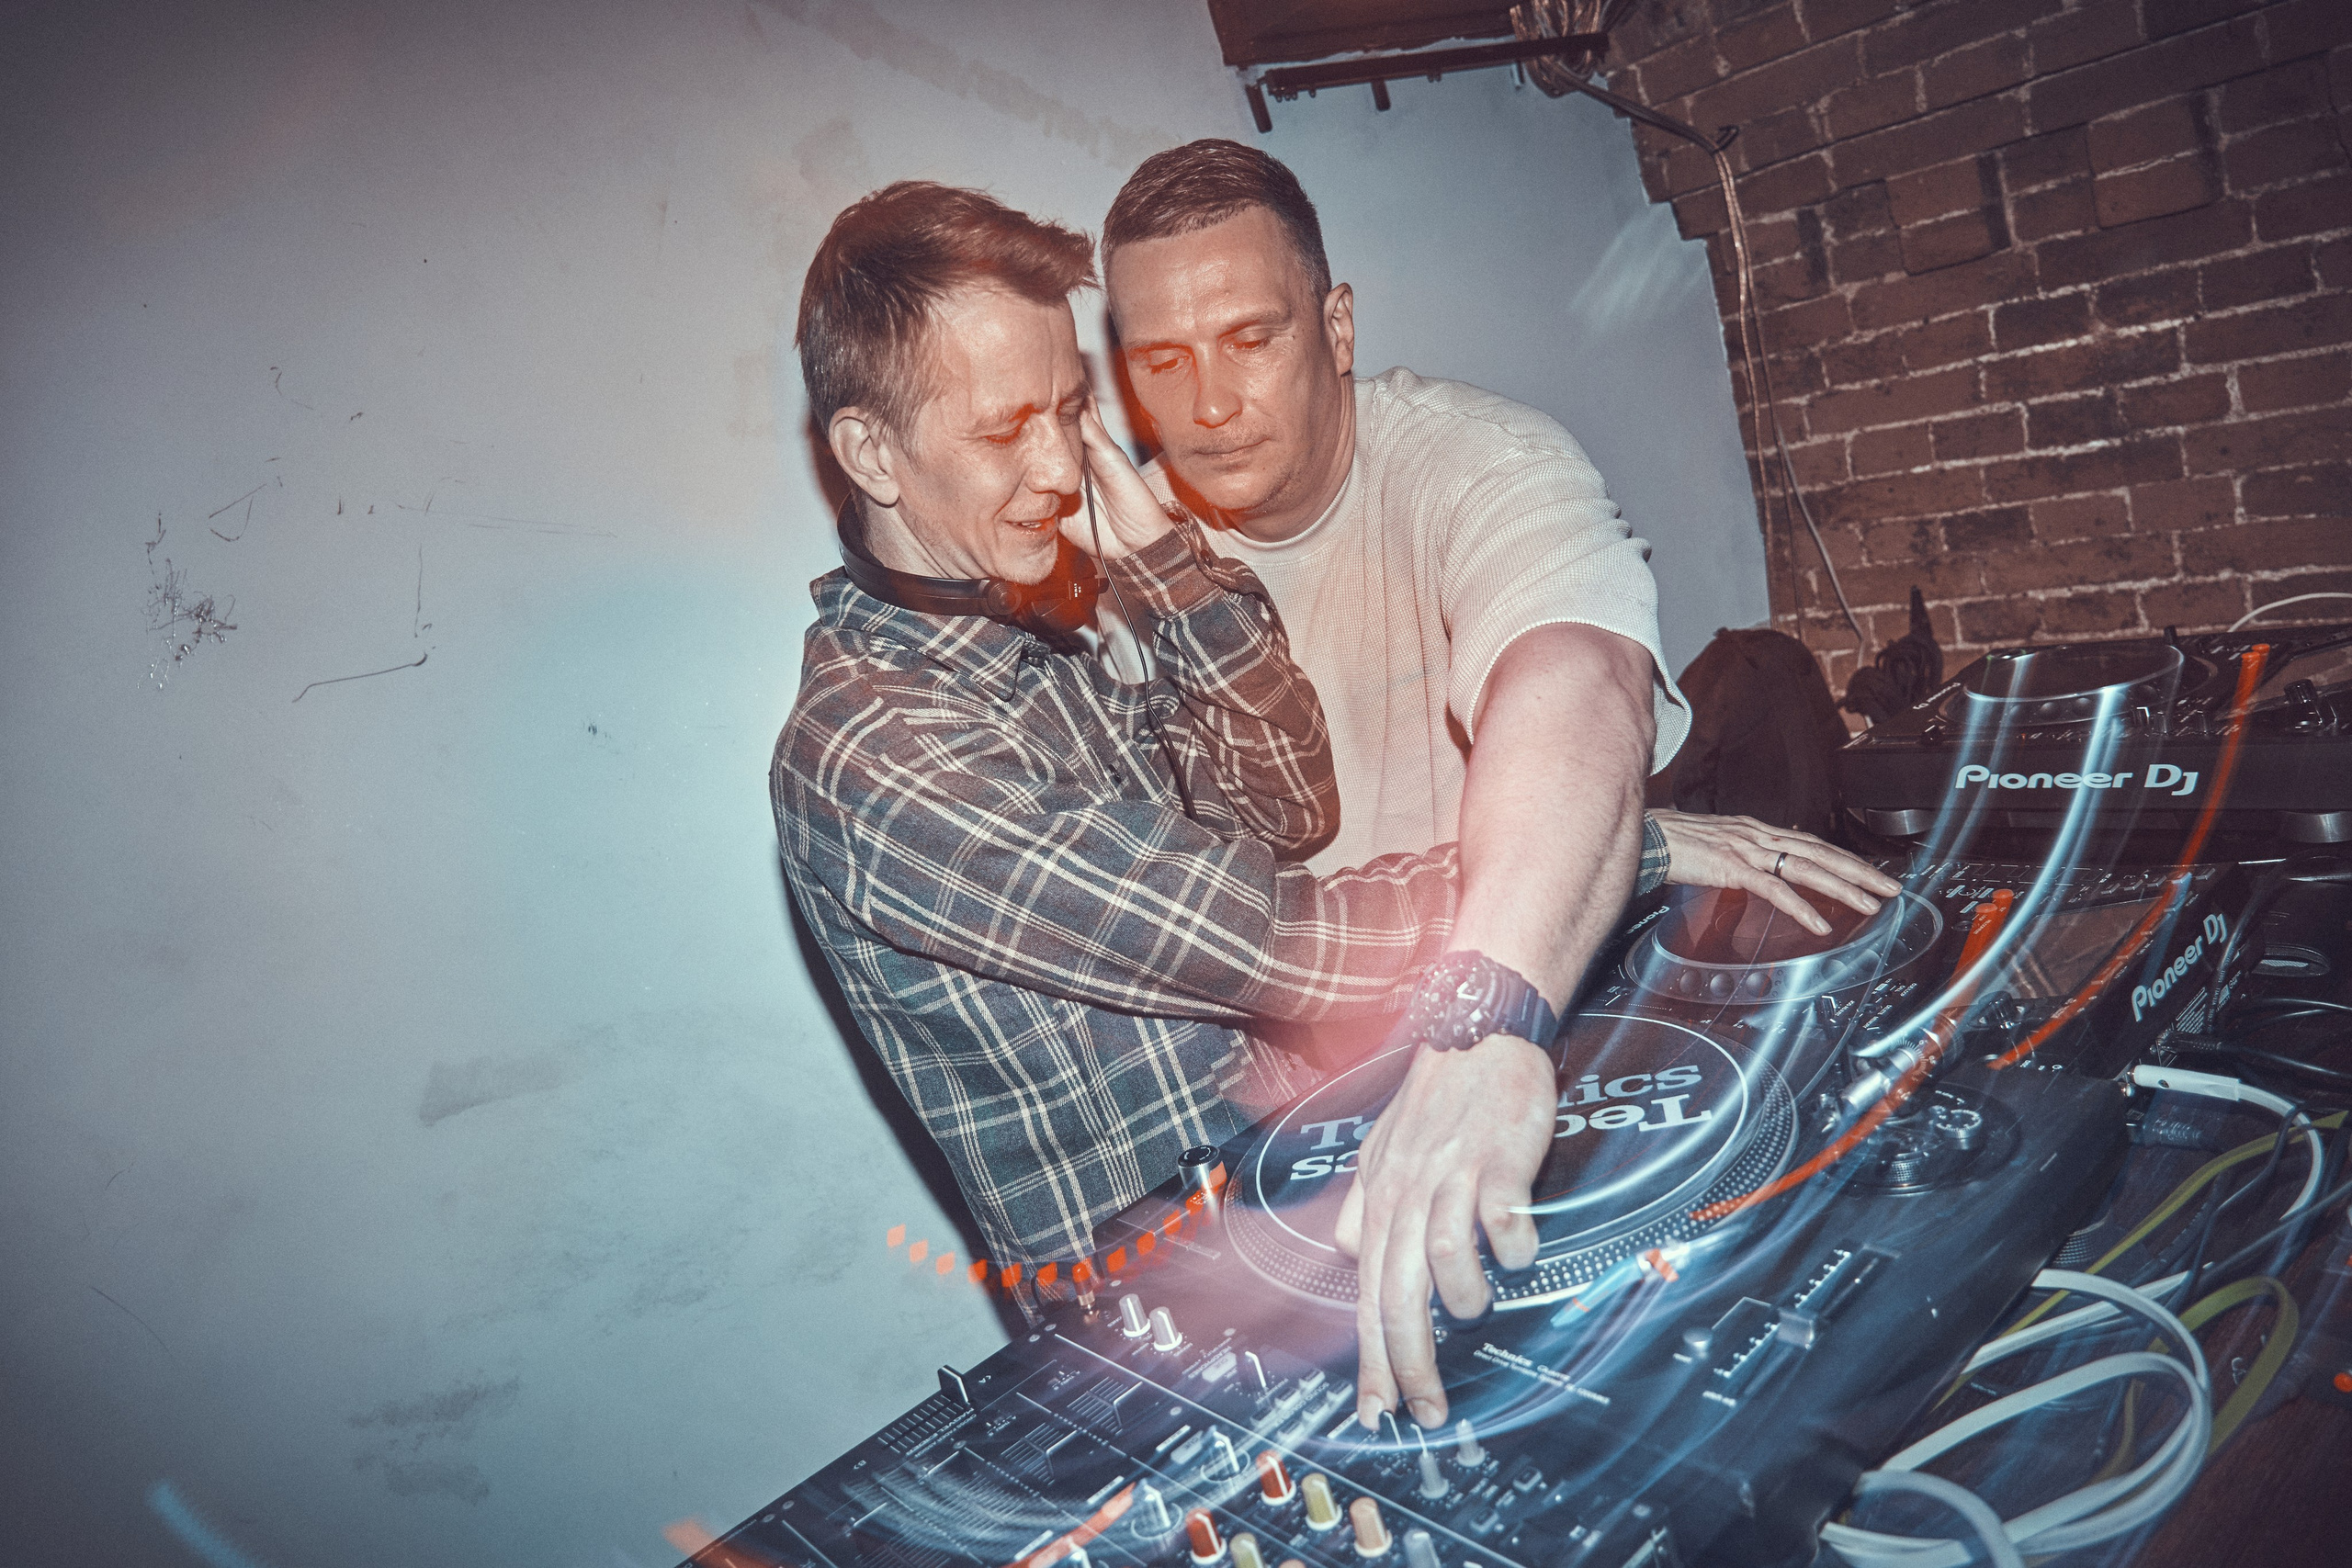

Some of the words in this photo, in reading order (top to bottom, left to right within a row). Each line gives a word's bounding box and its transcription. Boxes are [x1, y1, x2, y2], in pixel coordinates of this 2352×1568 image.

[1955, 764, 2133, 789] Pioneer
[2132, 935, 2203, 1022] Pioneer
[1186, 1344, 1232, 1380] HEADPHONES
[1482, 1342, 1533, 1367] Technics
